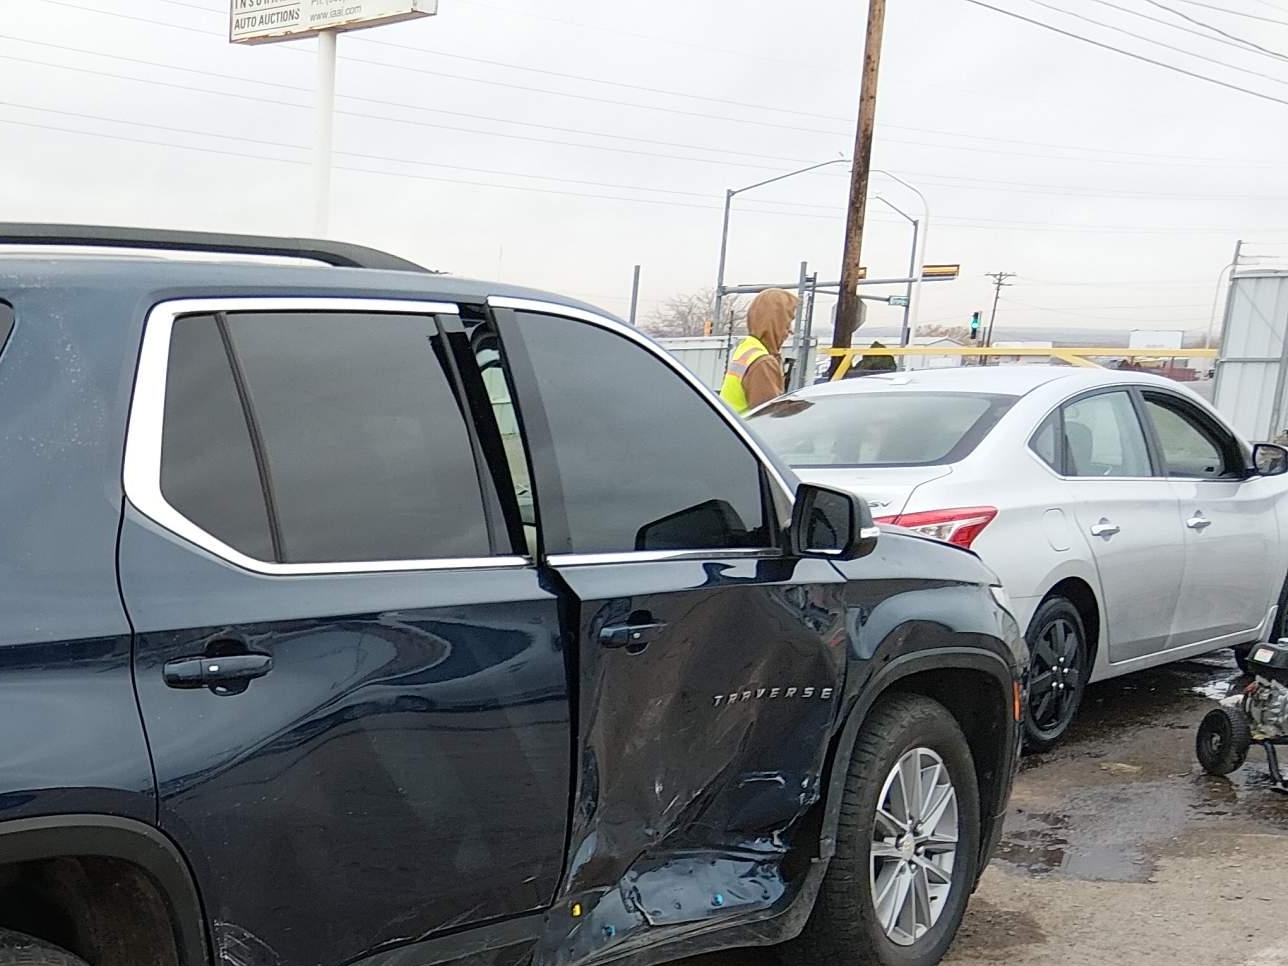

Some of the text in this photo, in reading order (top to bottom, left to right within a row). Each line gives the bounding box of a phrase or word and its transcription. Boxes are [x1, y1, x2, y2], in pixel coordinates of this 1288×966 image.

[234, 8, 300, 30] AUTO AUCTIONS
[713, 687, 832, 706] TRAVERSE
